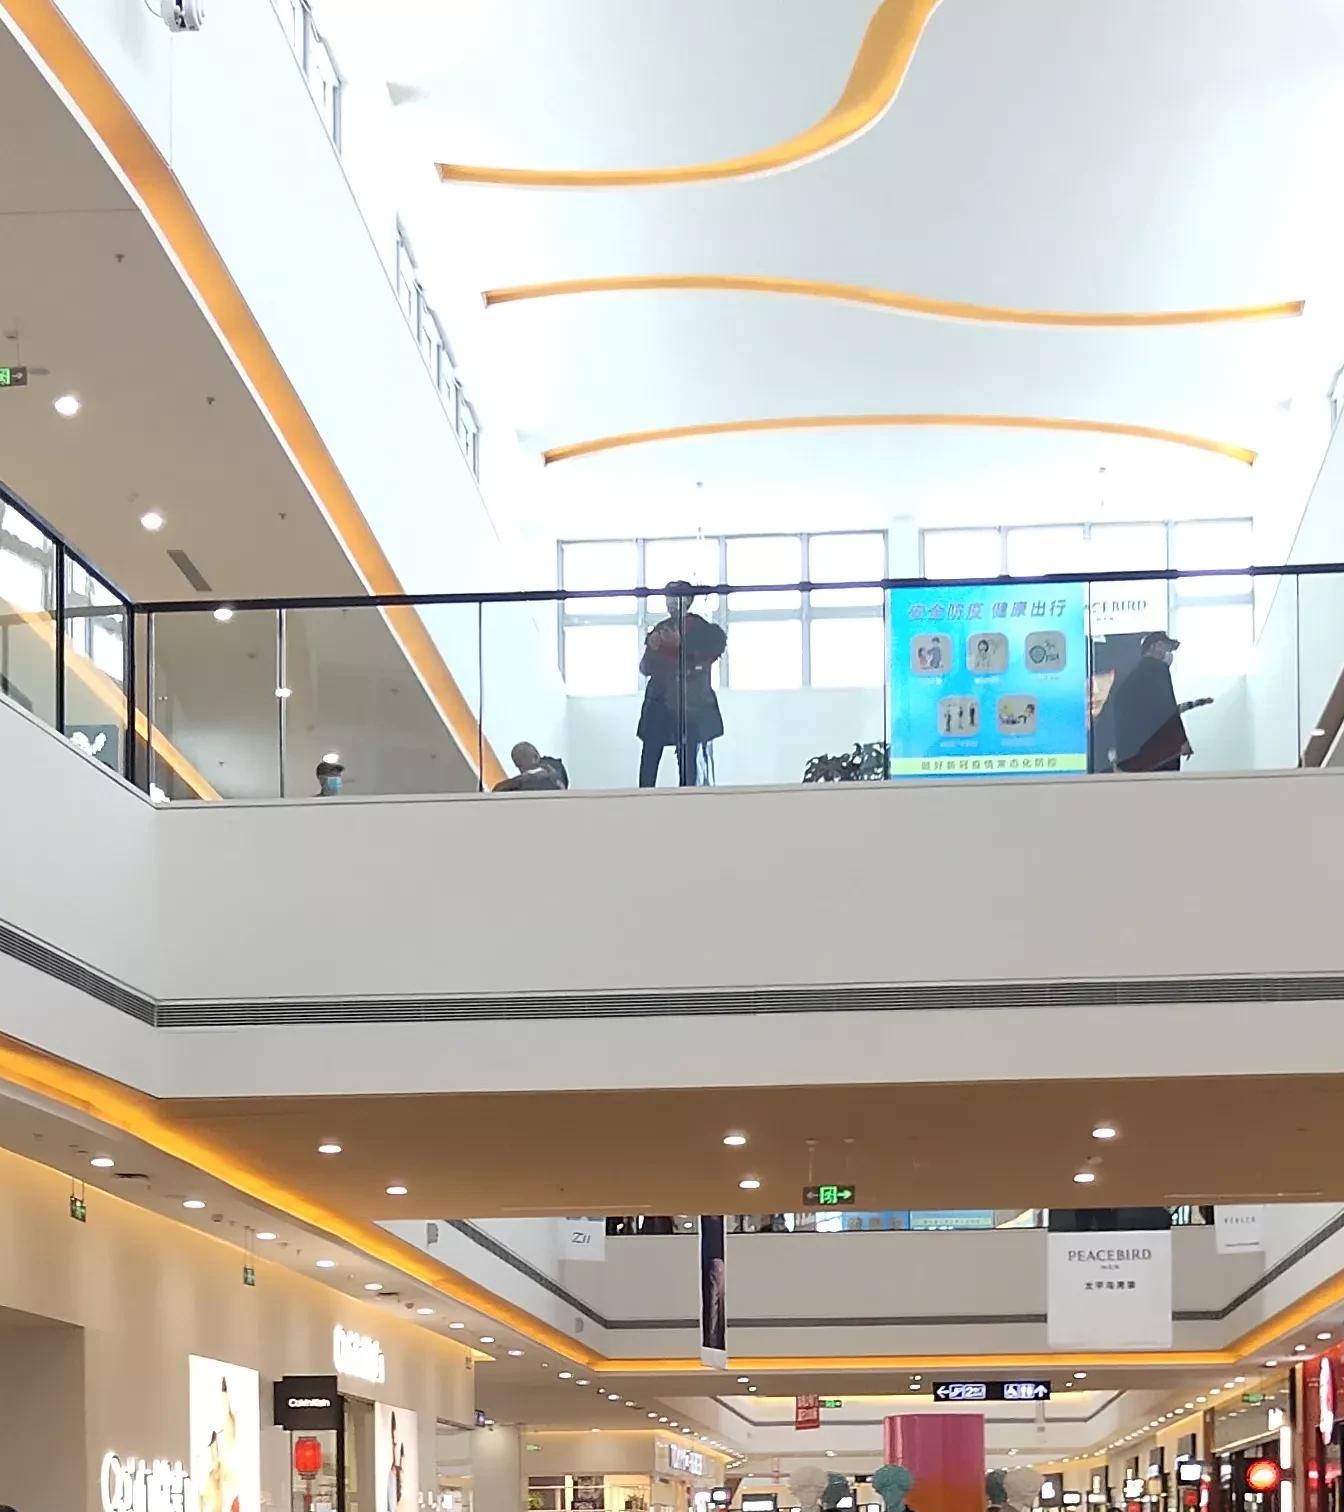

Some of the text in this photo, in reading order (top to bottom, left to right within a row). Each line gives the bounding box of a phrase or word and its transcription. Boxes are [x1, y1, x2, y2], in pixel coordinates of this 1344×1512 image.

[992, 599, 1067, 619] 健康出行
[1068, 1248, 1152, 1261] PEACEBIRD
